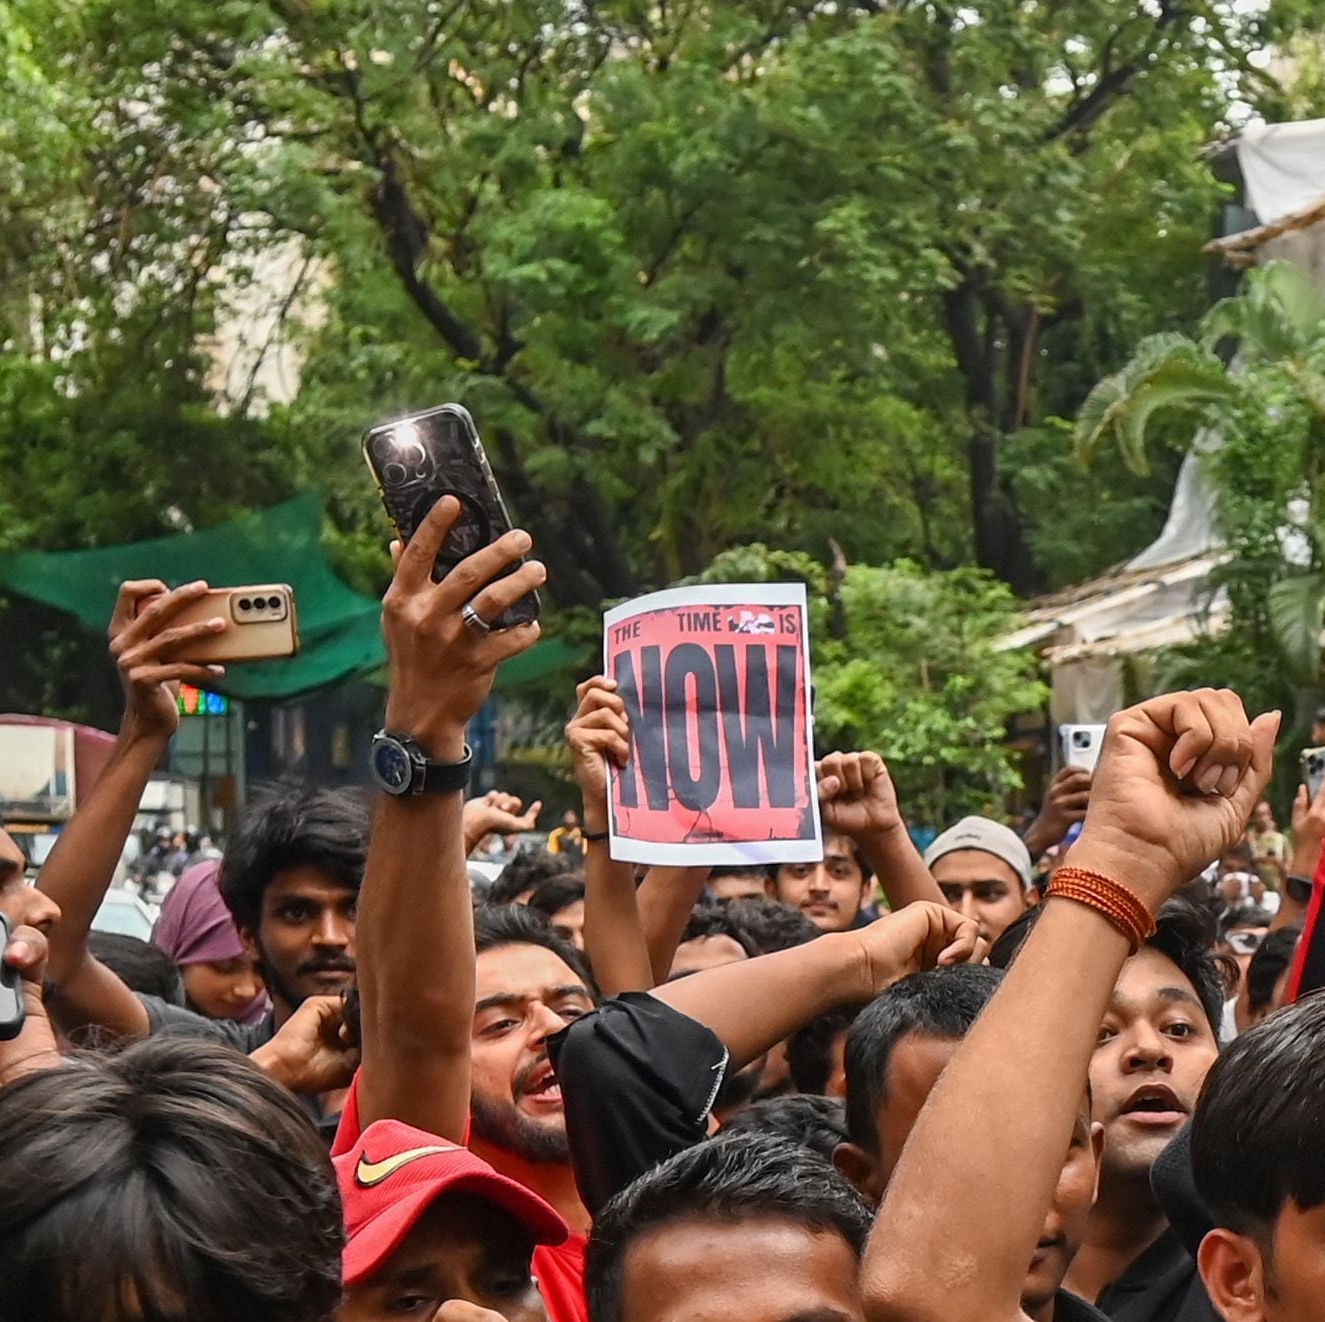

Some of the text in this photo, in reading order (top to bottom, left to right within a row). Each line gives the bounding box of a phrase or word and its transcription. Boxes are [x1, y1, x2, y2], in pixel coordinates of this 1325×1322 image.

[614, 612, 797, 645] THE TIME IS
[613, 643, 798, 811] NOW
